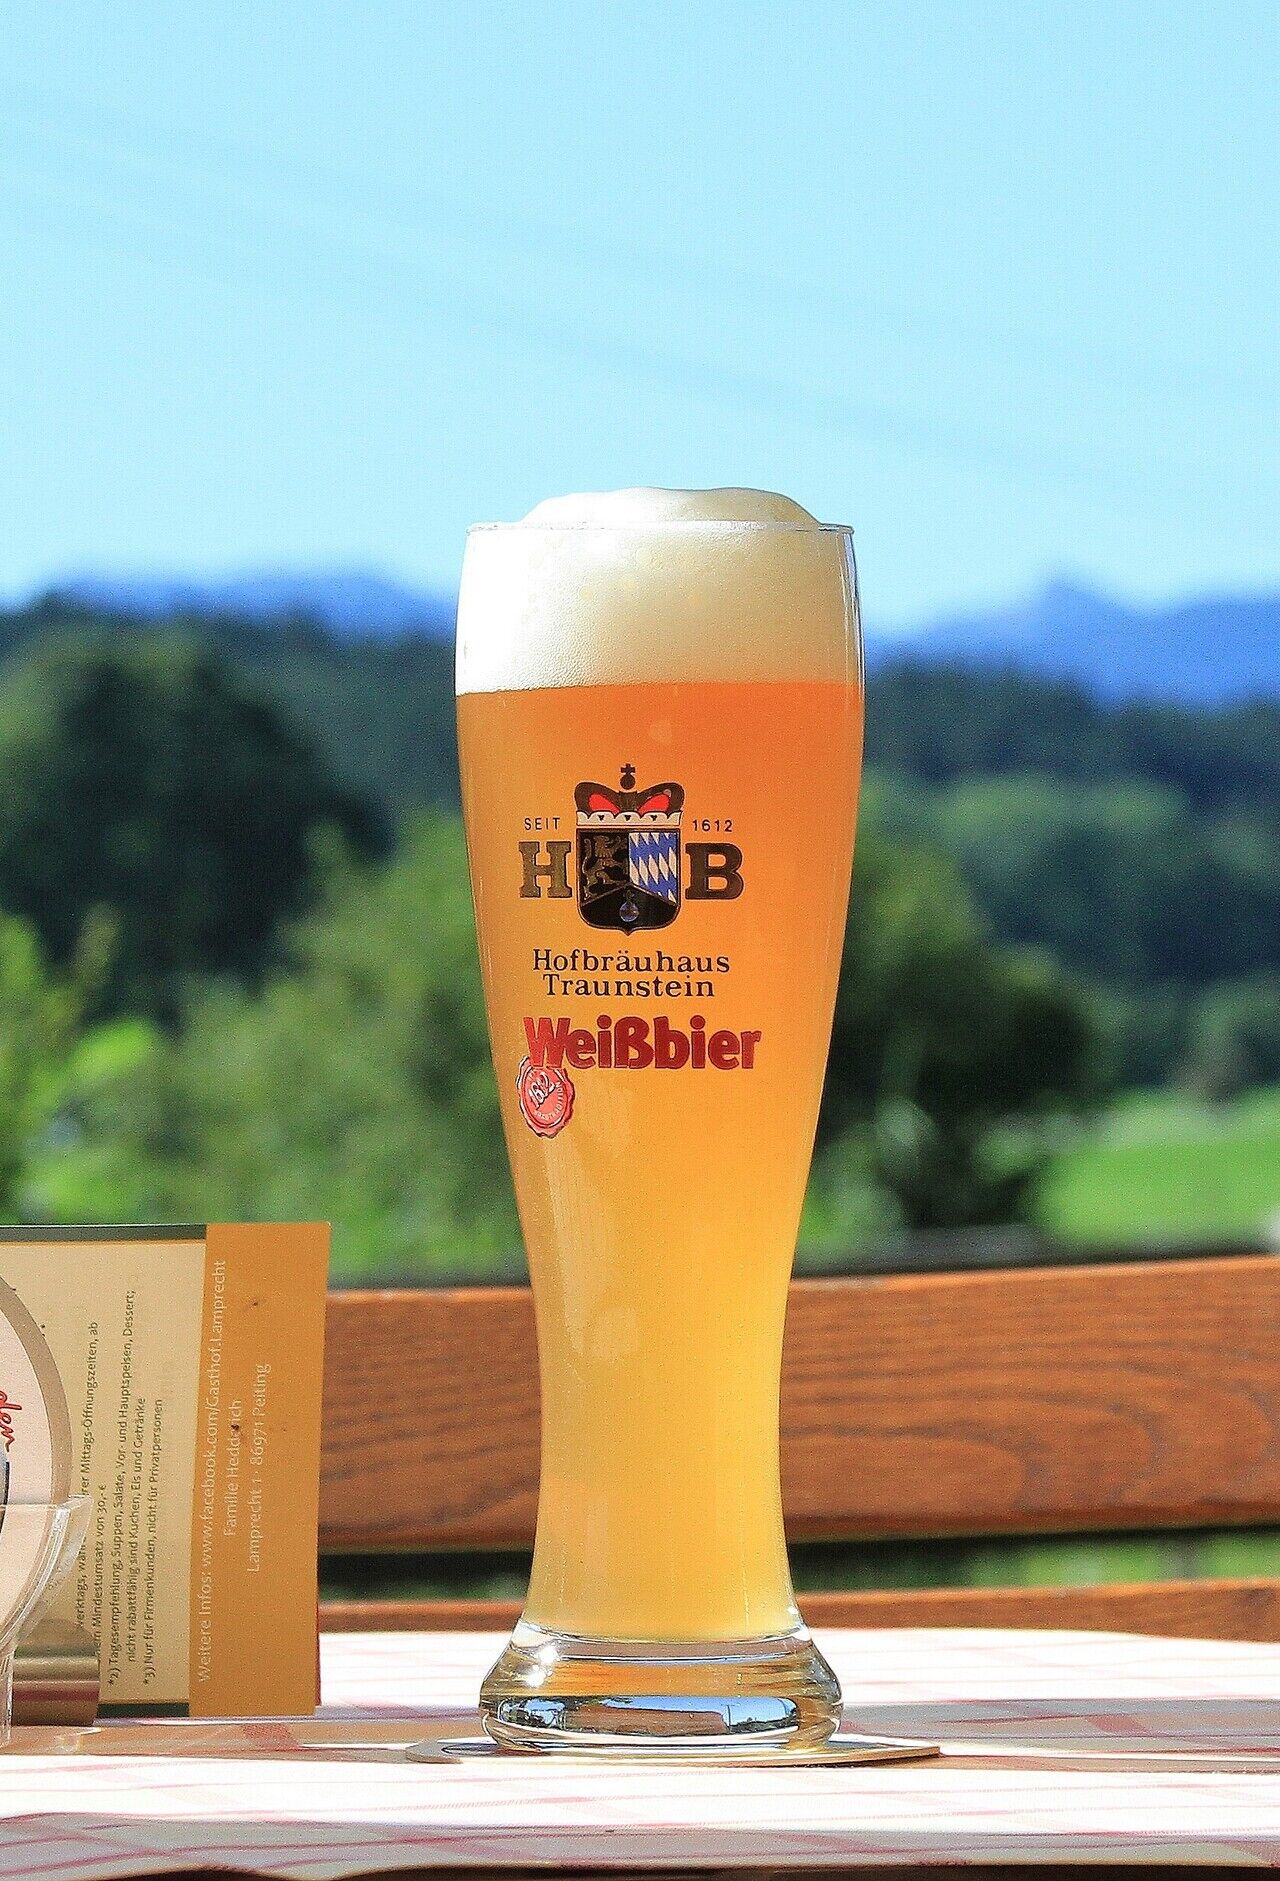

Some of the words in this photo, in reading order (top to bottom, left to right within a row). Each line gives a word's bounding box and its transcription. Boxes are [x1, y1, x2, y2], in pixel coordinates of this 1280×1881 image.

[523, 817, 561, 831] SEIT
[691, 819, 734, 832] 1612
[518, 841, 573, 898] H
[684, 842, 745, 900] B
[532, 948, 730, 973] Hofbräuhaus
[542, 974, 716, 997] Traunstein
[522, 1014, 762, 1070] Weißbier
[86, 1321, 99, 1337] ab
[122, 1290, 137, 1337] Dessert;
[118, 1339, 134, 1418] Hauptspeisen,
[251, 1363, 271, 1417] Peiting
[117, 1421, 128, 1443] und
[132, 1397, 146, 1449] Getränke
[148, 1399, 162, 1484] Privatpersonen
[225, 1399, 242, 1478] Heddeich
[250, 1420, 268, 1466] 86971
[114, 1445, 126, 1469] Vor-
[132, 1451, 142, 1473] und
[113, 1471, 127, 1508] Salate,
[131, 1475, 141, 1491] Eis
[147, 1486, 158, 1502] für
[95, 1515, 105, 1538] von
[128, 1493, 142, 1540] Kuchen,
[146, 1503, 158, 1534] nicht
[223, 1481, 239, 1536] Familie
[246, 1489, 264, 1573] Lamprecht
[110, 1511, 125, 1557] Suppen,
[127, 1541, 139, 1564] sind
[90, 1540, 103, 1628] Mindestumsatz
[126, 1568, 140, 1631] rabattfähig
[143, 1536, 157, 1621] Firmenkunden,
[197, 1571, 211, 1616] Infos:
[108, 1559, 123, 1666] Tagesempfehlung,
[143, 1624, 154, 1641] für
[126, 1633, 137, 1663] nicht
[143, 1643, 154, 1665] Nur
[197, 1620, 211, 1682] Weitere
